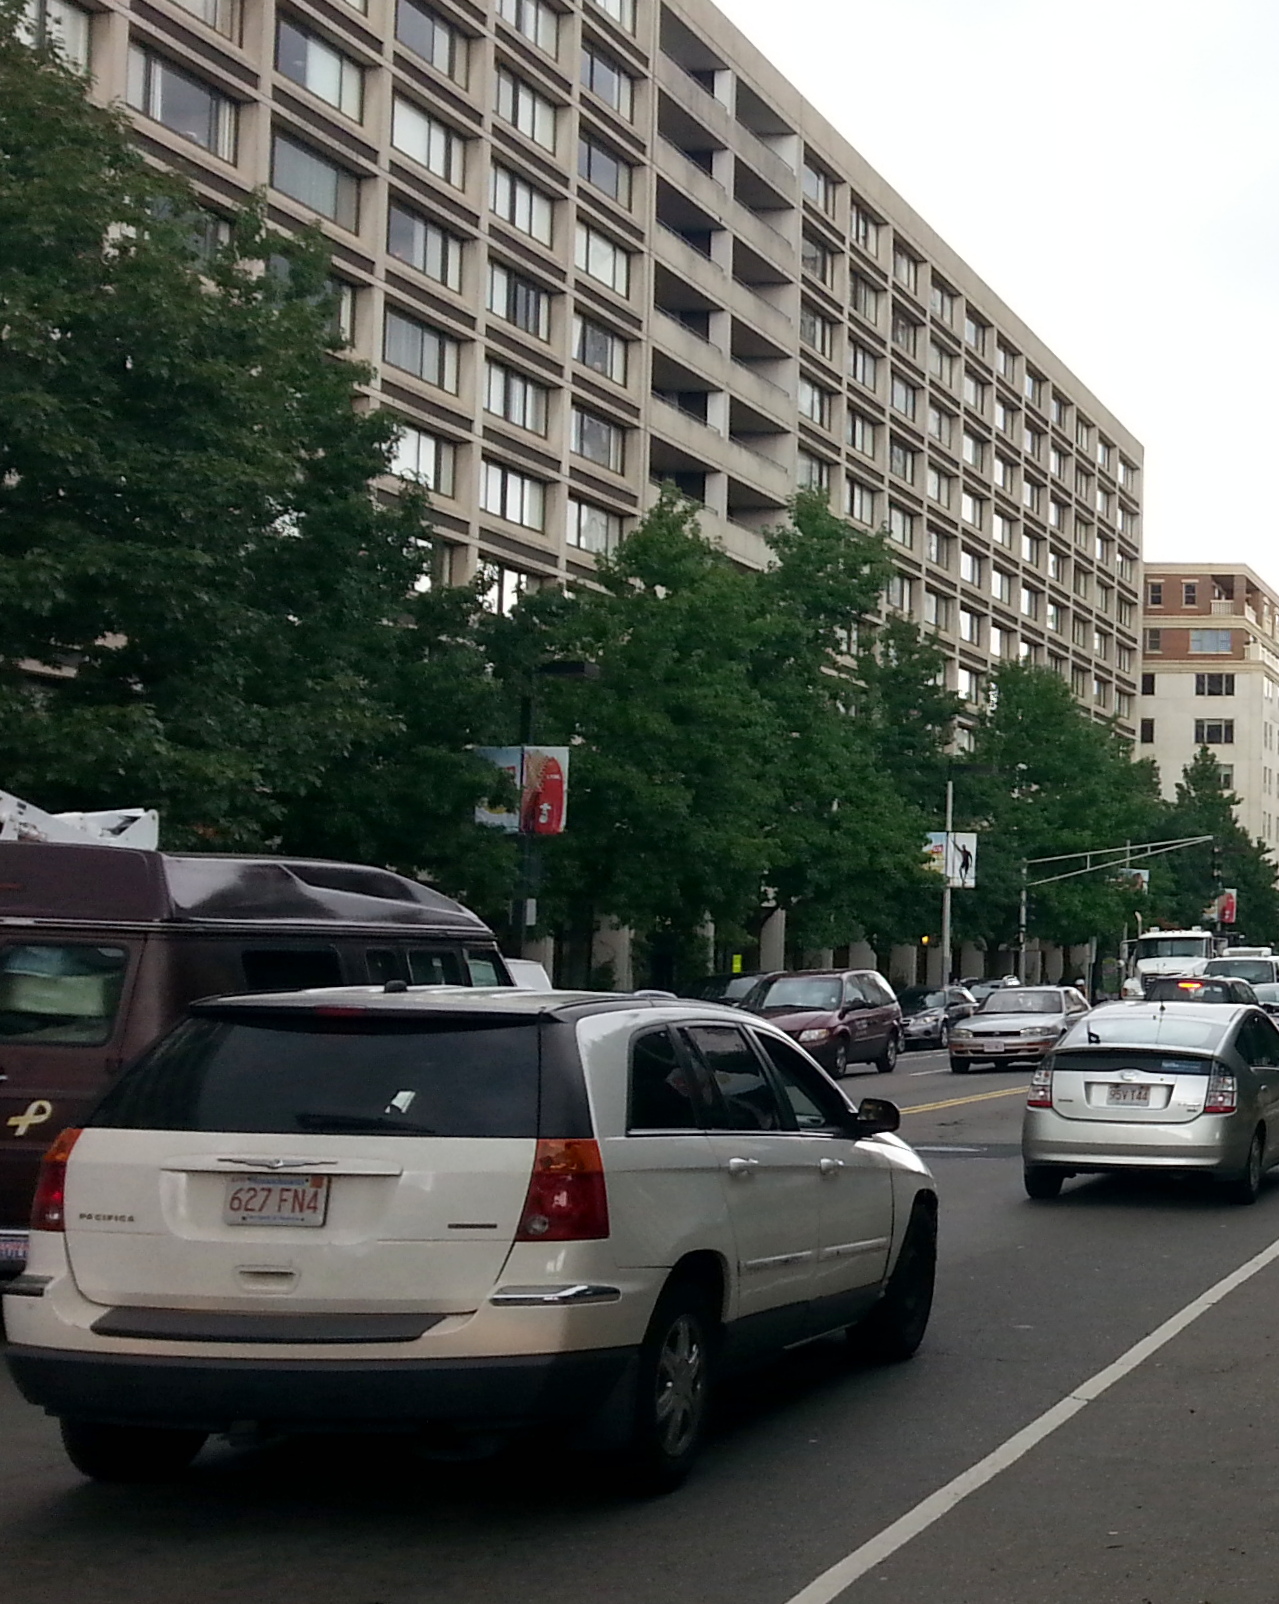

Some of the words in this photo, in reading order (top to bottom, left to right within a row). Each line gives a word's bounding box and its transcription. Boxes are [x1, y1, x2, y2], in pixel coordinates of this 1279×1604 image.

[229, 1187, 272, 1212] 627
[277, 1188, 319, 1213] FN4
[79, 1213, 134, 1222] PACIFICA
